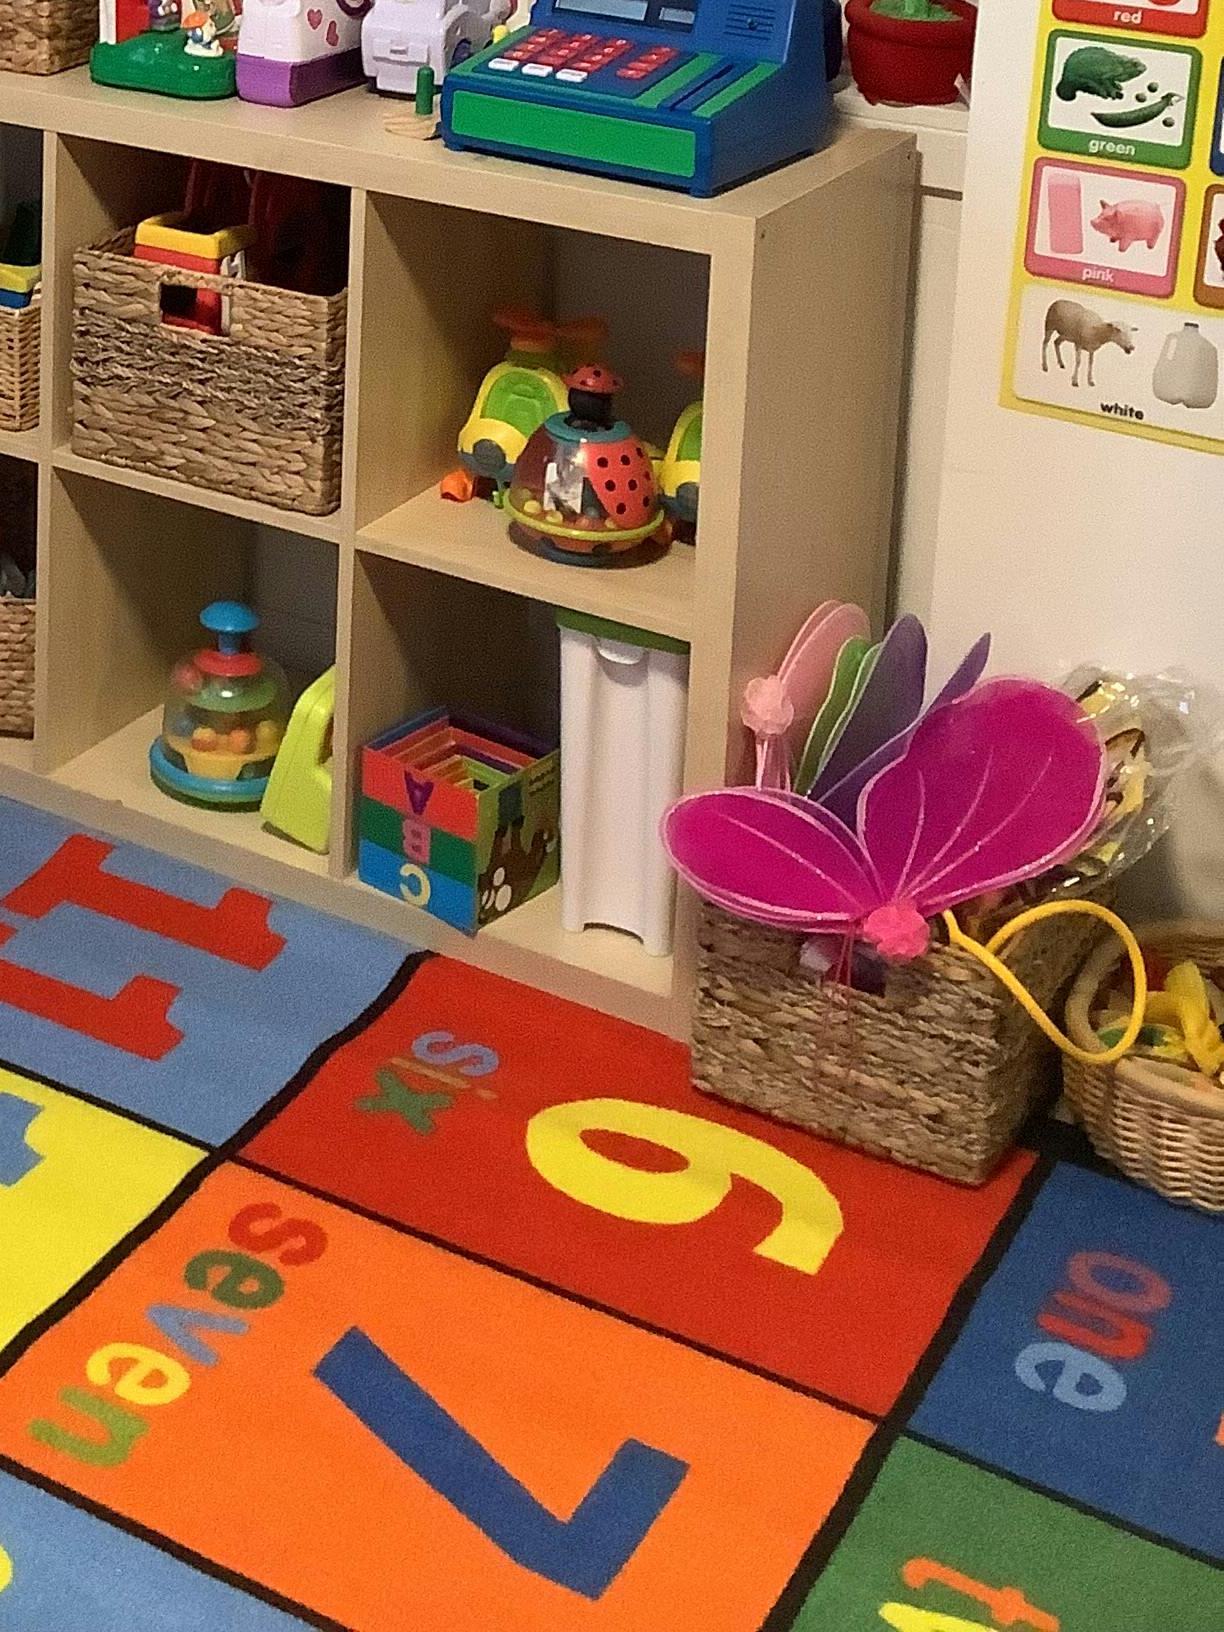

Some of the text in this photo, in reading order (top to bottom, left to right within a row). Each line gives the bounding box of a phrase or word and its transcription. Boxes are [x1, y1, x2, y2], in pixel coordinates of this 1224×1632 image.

[1113, 9, 1143, 24] red
[1088, 138, 1136, 156] green
[1082, 267, 1115, 283] pink
[1100, 401, 1145, 420] white
[403, 769, 435, 816] A
[402, 817, 431, 865] B
[399, 862, 431, 906] C
[353, 1029, 500, 1137] six
[526, 1097, 845, 1276] 6
[30, 1201, 331, 1471] seven
[1014, 1249, 1174, 1414] one
[312, 1325, 691, 1602] 7
